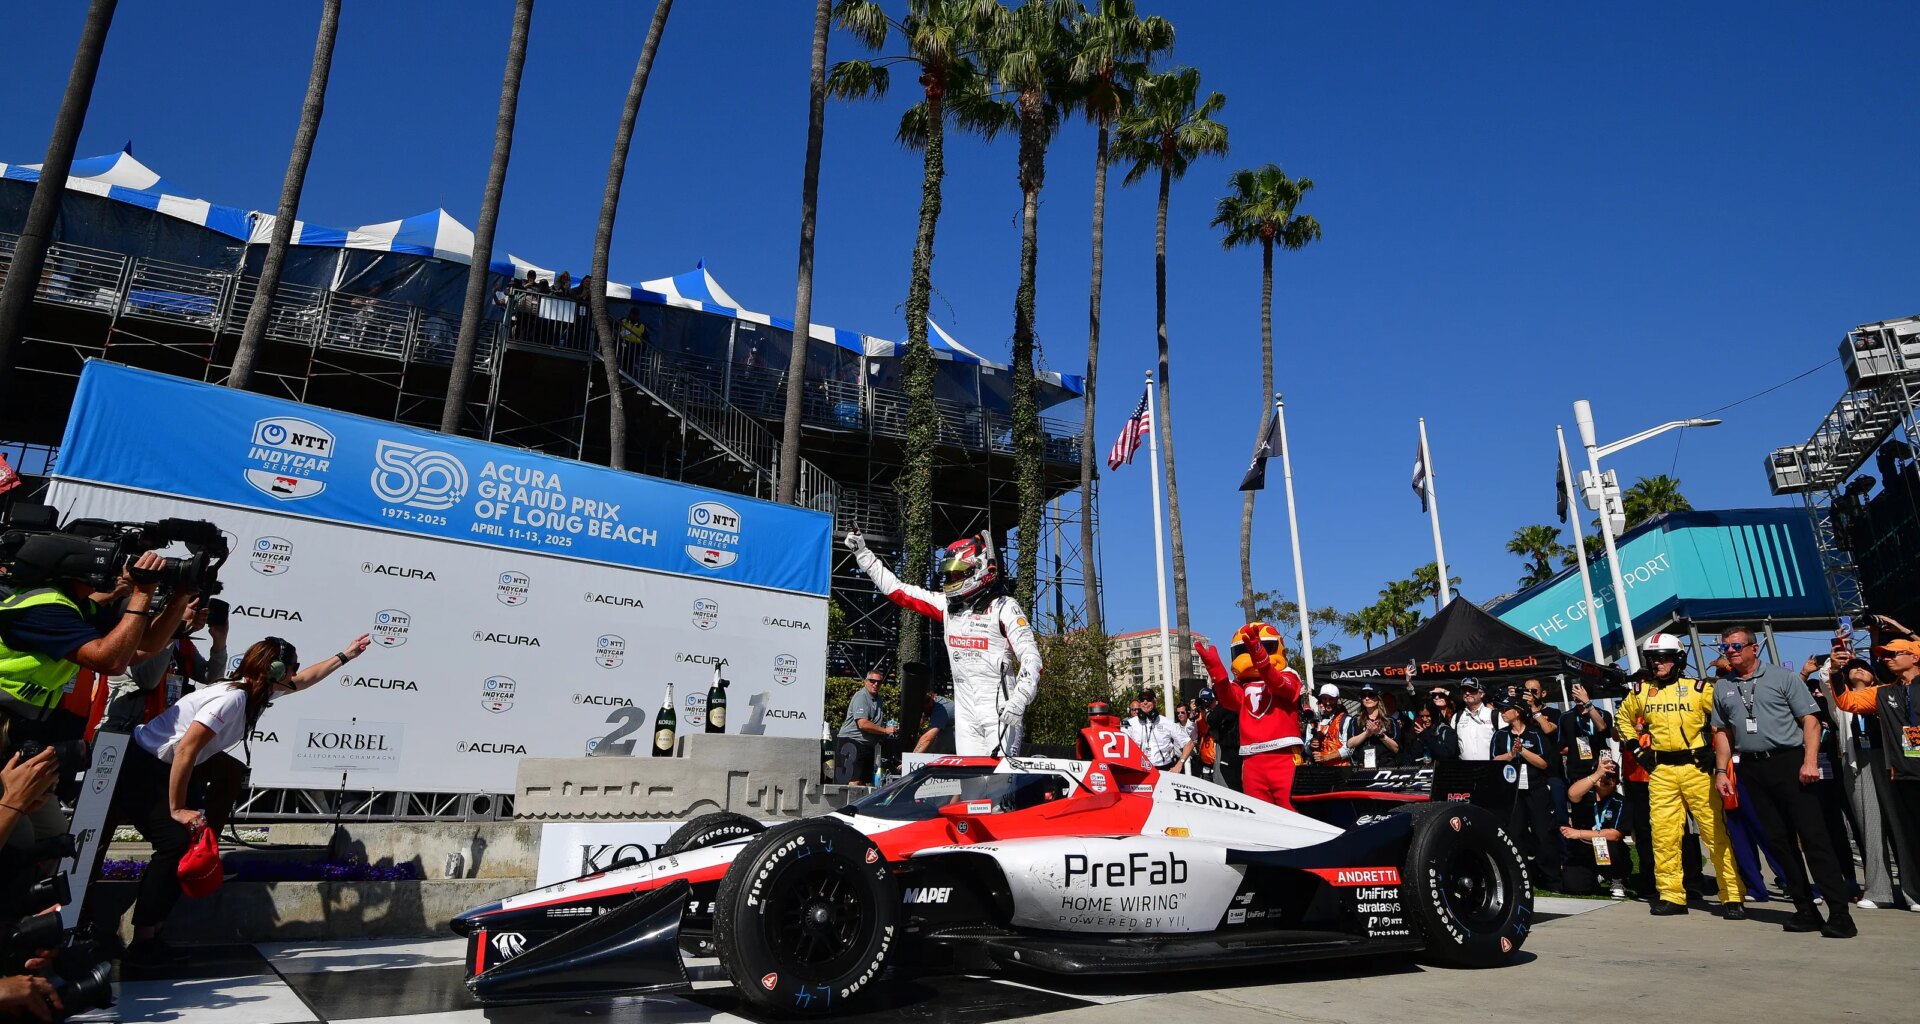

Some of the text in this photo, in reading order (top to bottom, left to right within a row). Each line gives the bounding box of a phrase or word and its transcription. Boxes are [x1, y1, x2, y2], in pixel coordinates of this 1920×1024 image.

[291, 433, 328, 450] NTT
[248, 447, 330, 472] INDYCAR
[263, 461, 310, 476] SERIES
[480, 461, 561, 492] ACURA
[478, 480, 621, 521] GRAND PRIX
[382, 508, 447, 526] 1975-2025
[474, 500, 657, 546] OF LONG BEACH
[713, 514, 736, 527] NTT
[471, 522, 572, 547] APRIL 11-13, 2025
[687, 527, 739, 545] INDYCAR
[272, 543, 290, 552] NTT
[697, 539, 727, 548] SERIES
[96, 556, 105, 564] 15
[252, 551, 291, 562] INDYCAR
[374, 564, 436, 581] ACURA
[498, 585, 528, 594] INDYCAR
[595, 594, 644, 608] ACURA
[1528, 613, 1567, 642] THE
[1624, 553, 1671, 589] PORT
[232, 605, 302, 622] ACURA
[693, 611, 718, 619] INDYCAR
[374, 624, 409, 634] INDYCAR
[771, 618, 811, 630] ACURA
[484, 633, 541, 647] ACURA
[950, 639, 985, 648] ANDRETTI
[684, 654, 729, 667] ACURA
[1339, 656, 1538, 680] ACURA Gra Prix of Long Beach
[353, 677, 418, 691] ACURA
[499, 682, 513, 690] NTT
[482, 691, 514, 699] INDYCAR
[583, 695, 634, 707] ACURA
[740, 690, 771, 735] 1
[766, 709, 807, 720] ACURA
[1644, 703, 1693, 714] OFFICIAL
[250, 731, 279, 743] RA
[592, 706, 646, 757] 2
[307, 732, 388, 751] KORBEL
[1098, 731, 1130, 758] 27
[468, 743, 527, 755] ACURA
[1024, 762, 1056, 770] PreFab
[1065, 852, 1188, 887] PreFab
[1497, 828, 1531, 899] Firestone
[748, 835, 805, 907] Firestone
[1338, 870, 1397, 883] ANDRETTI
[903, 887, 953, 903] MAPEI
[1356, 887, 1398, 899] UniFirst
[1061, 896, 1112, 912] HOME
[1357, 902, 1401, 914] stratasys
[1429, 868, 1463, 944] Firestone
[1059, 916, 1138, 928] POWERED
[1145, 917, 1162, 927] BY
[841, 925, 894, 998] Firestone
